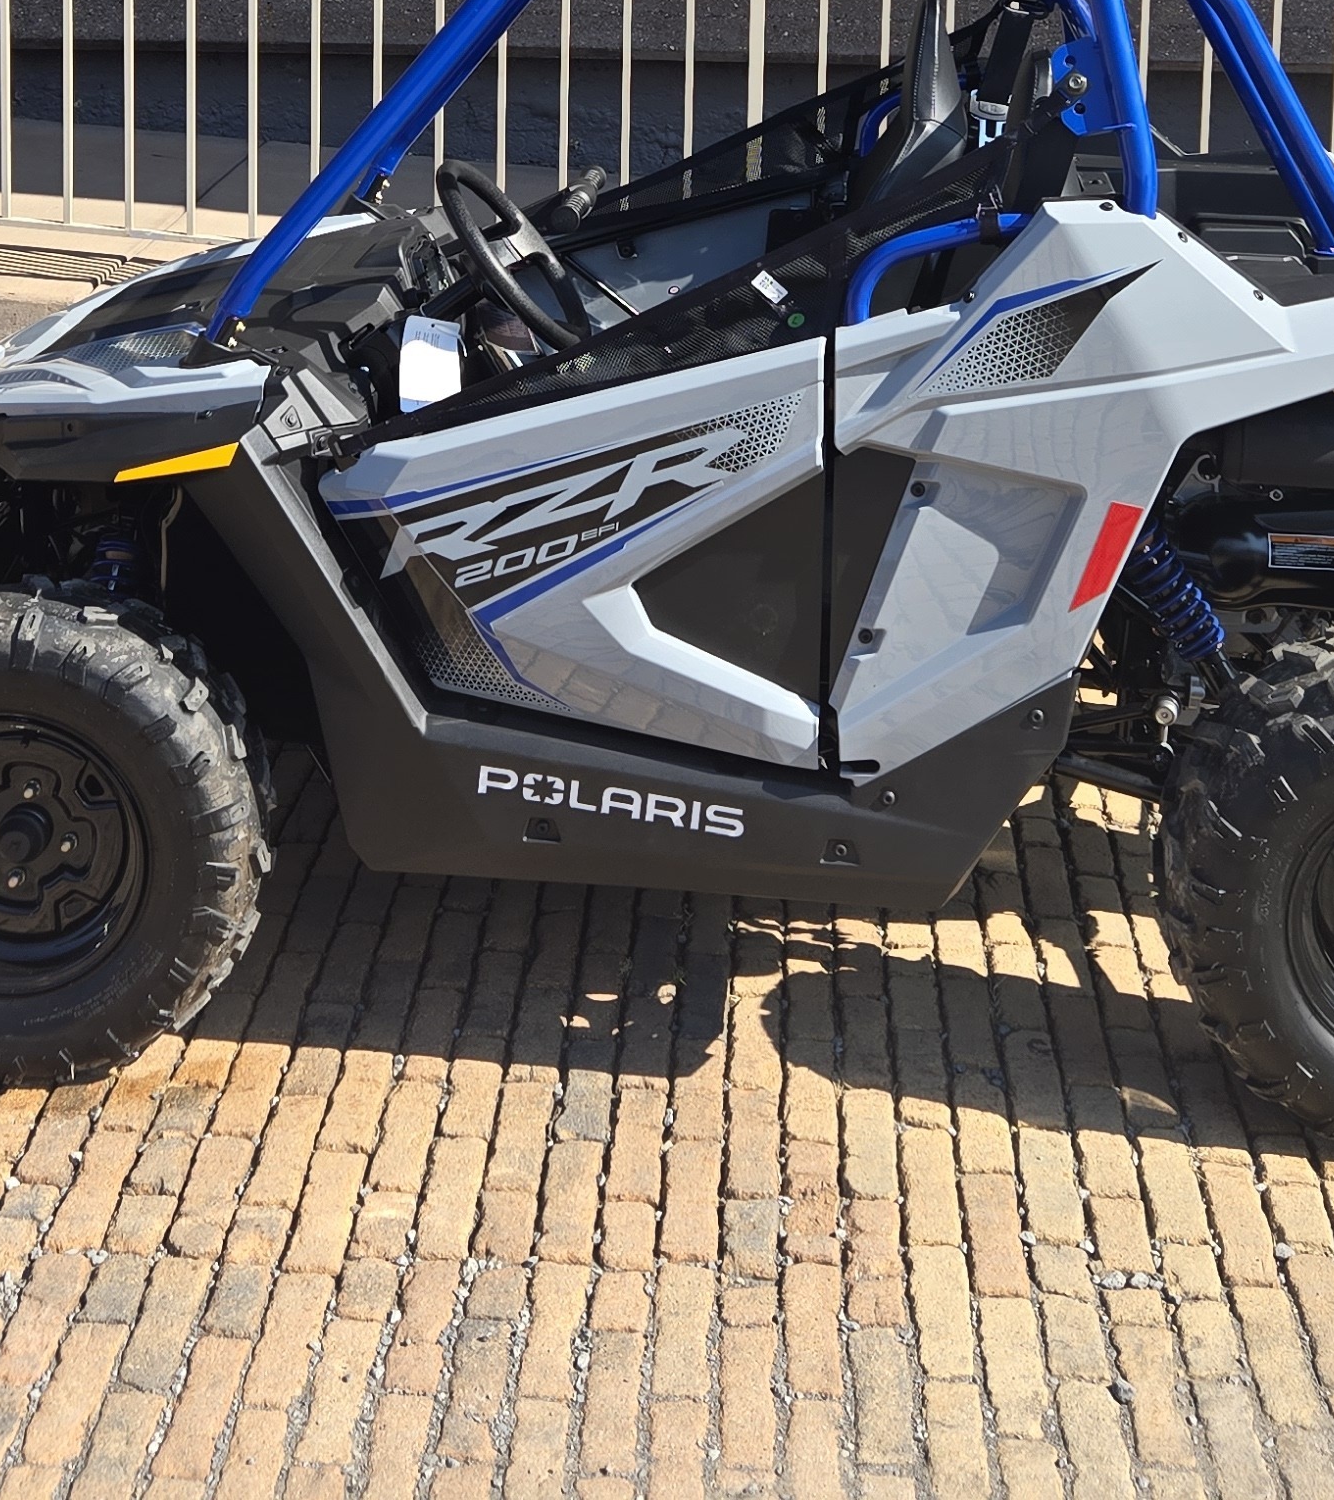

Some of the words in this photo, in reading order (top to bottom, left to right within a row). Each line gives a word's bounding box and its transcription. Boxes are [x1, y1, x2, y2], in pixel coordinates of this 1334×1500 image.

[380, 426, 749, 580] RZR
[454, 533, 579, 588] 200
[581, 521, 620, 542] EFI
[478, 764, 745, 838] POLARIS
